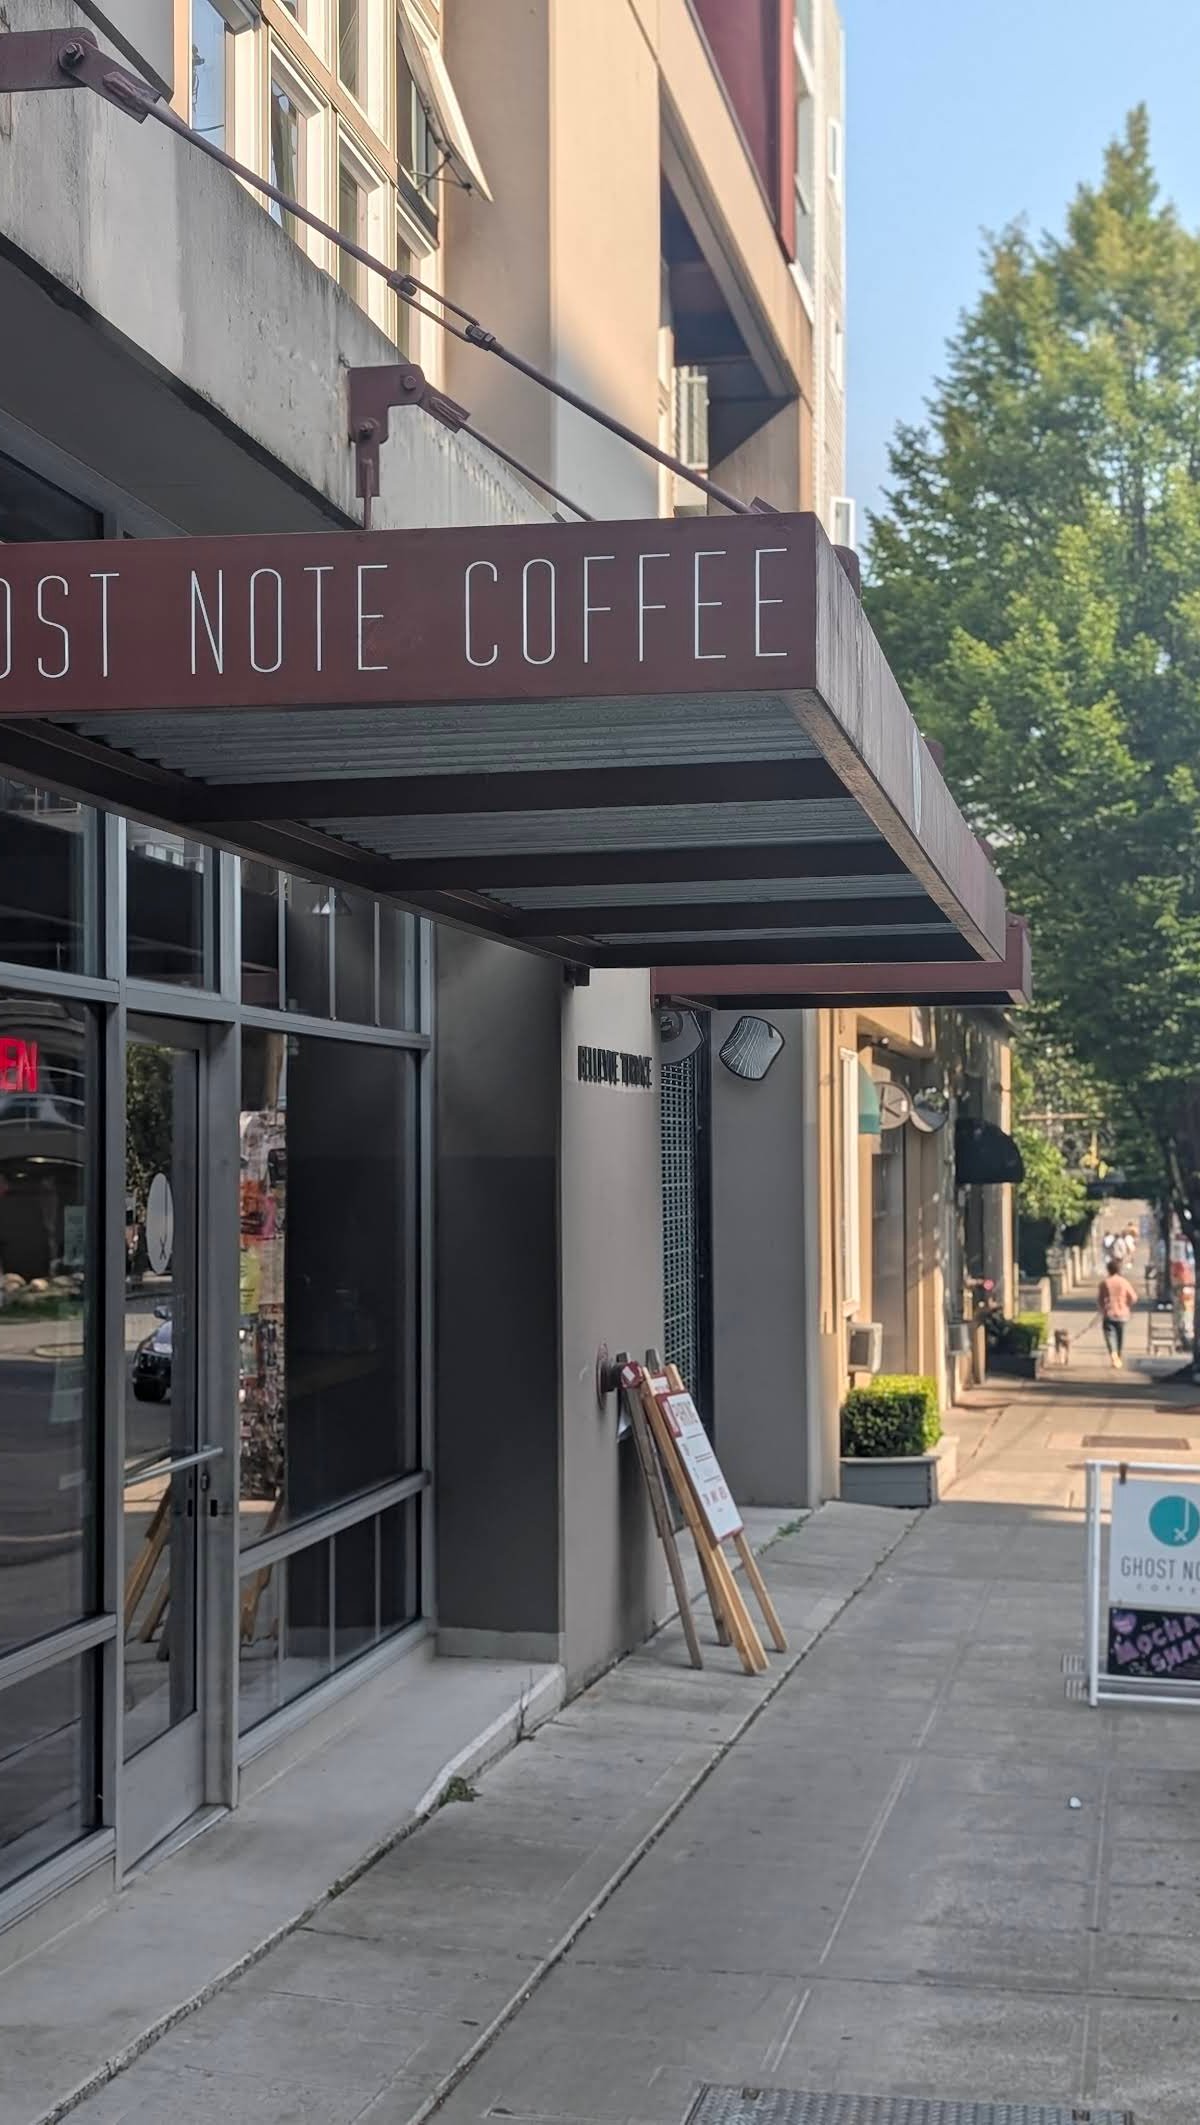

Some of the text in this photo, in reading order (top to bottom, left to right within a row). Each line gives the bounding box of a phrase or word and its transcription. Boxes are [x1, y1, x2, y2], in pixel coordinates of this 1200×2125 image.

[192, 564, 388, 675] NOTE
[466, 547, 788, 667] COFFEE
[1121, 1555, 1176, 1580] GHOST
